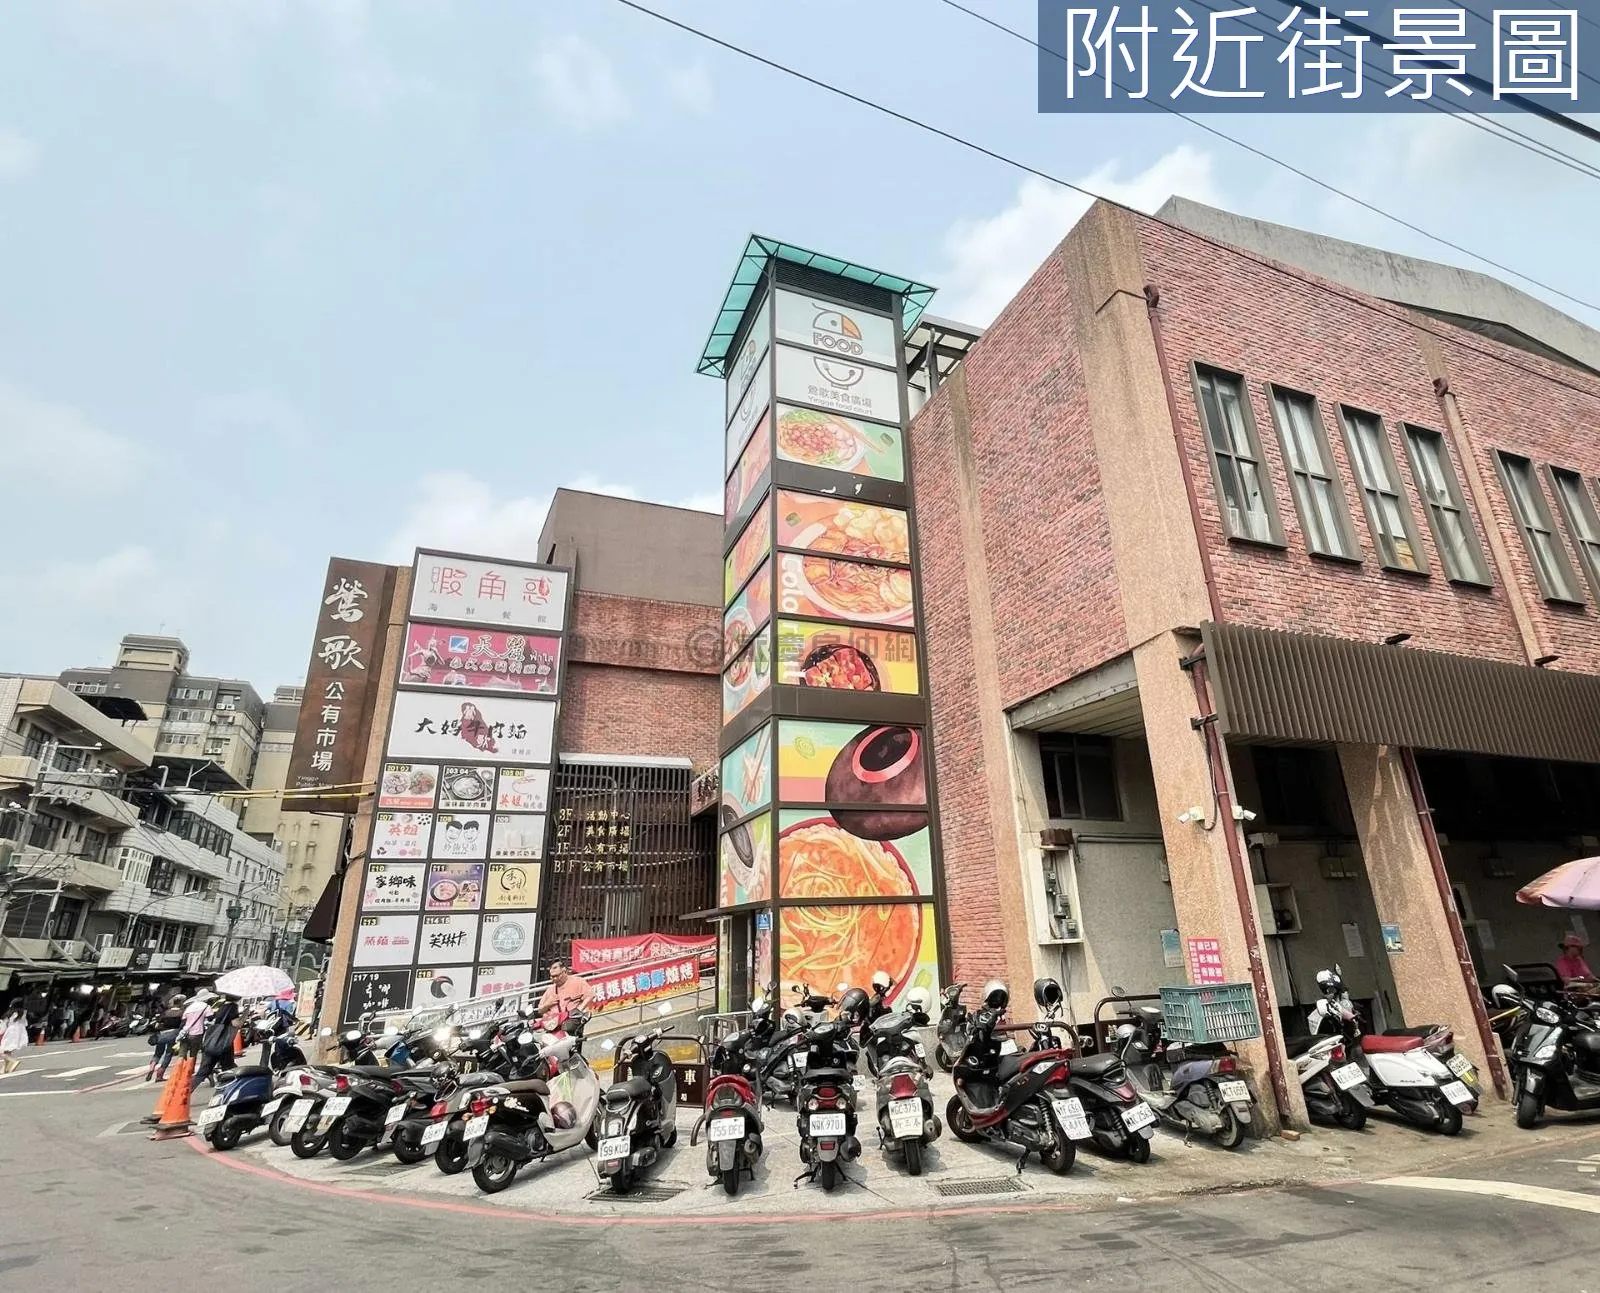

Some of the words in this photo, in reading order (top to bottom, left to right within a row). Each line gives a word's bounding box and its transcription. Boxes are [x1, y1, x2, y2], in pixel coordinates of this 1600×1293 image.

[812, 332, 864, 355] FOOD
[316, 577, 369, 671] 鶯歌
[310, 681, 345, 772] 公有市場
[415, 717, 527, 740] 大媽牛肉麵
[559, 808, 573, 821] 3F
[586, 809, 631, 821] 活動中心
[557, 825, 572, 837] 2F
[585, 825, 630, 838] 美食廣場
[556, 842, 571, 854] 1F
[584, 842, 629, 854] 公有市場
[554, 860, 576, 873] B1F
[582, 860, 629, 873] 公有市場
[375, 874, 417, 888] 家鄉味
[684, 1069, 696, 1086] 車
